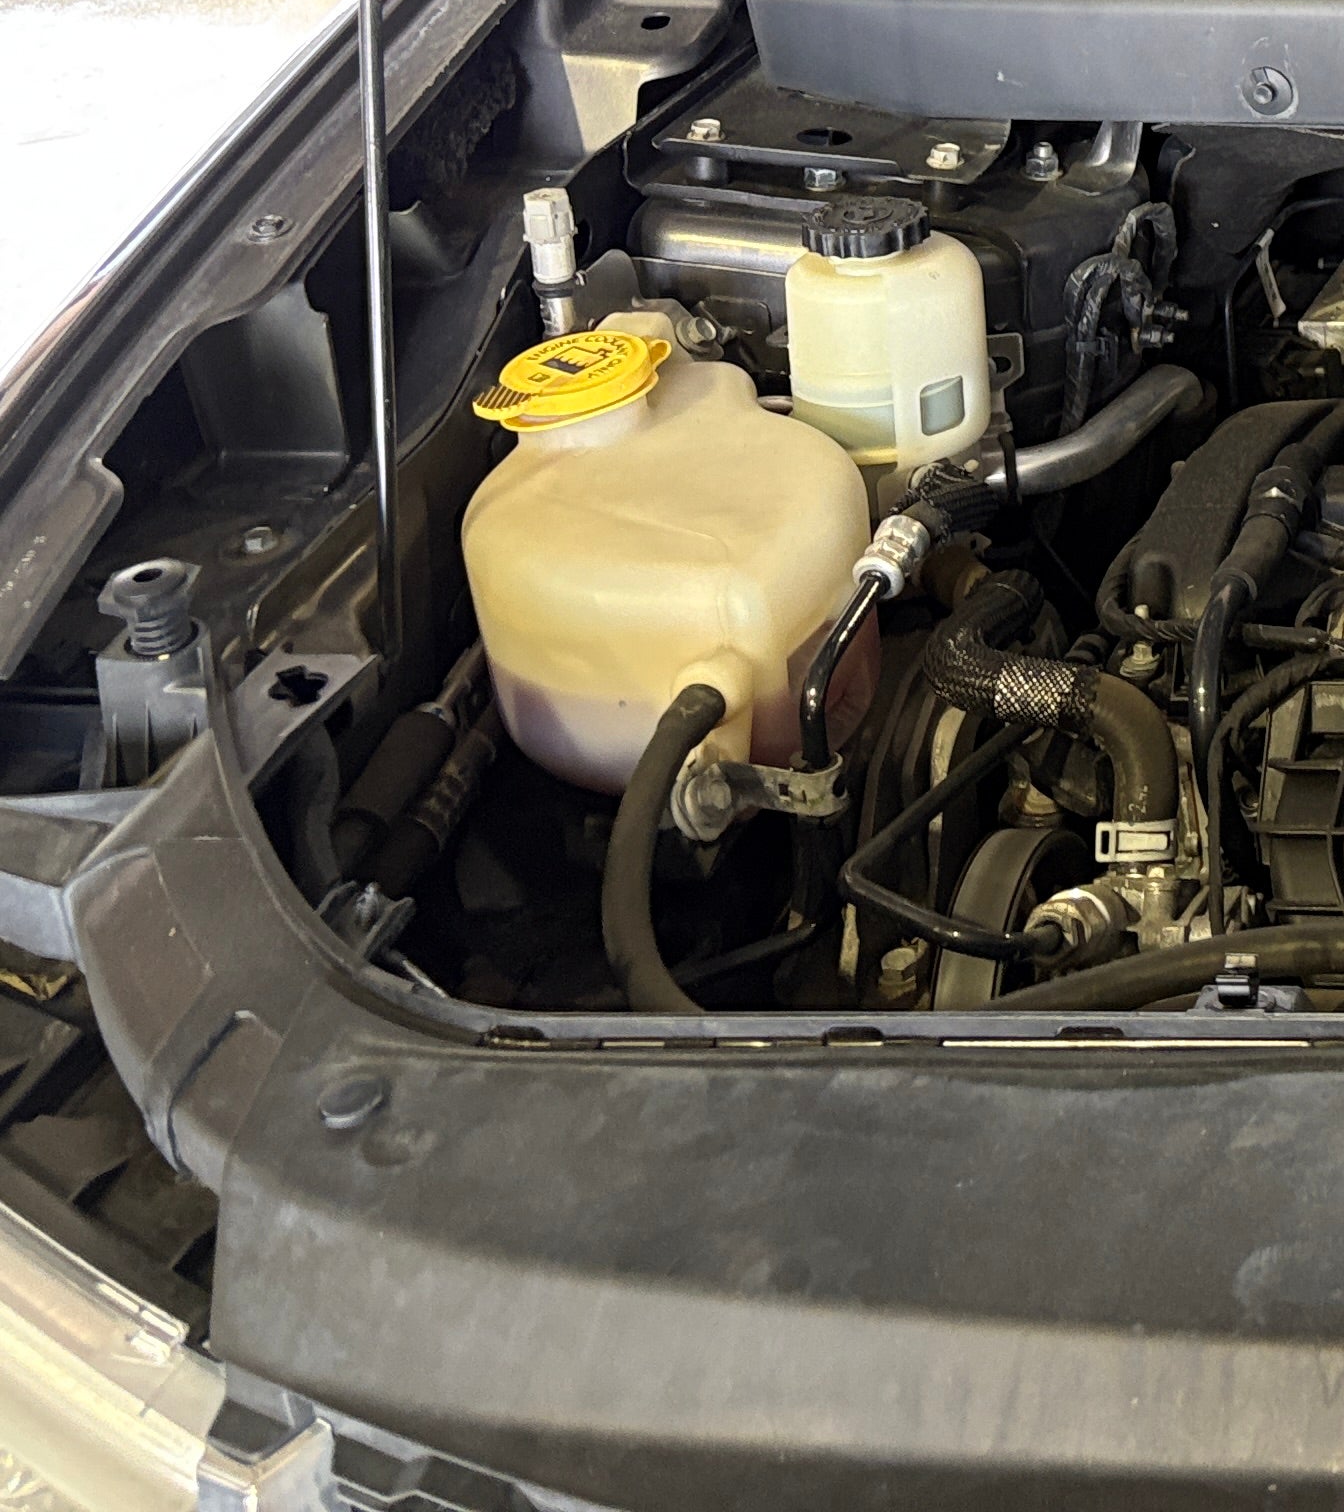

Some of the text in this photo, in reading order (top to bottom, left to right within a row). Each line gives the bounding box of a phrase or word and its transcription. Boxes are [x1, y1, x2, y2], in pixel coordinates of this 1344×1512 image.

[526, 334, 629, 380] ENGINE COOLANT ONLY
